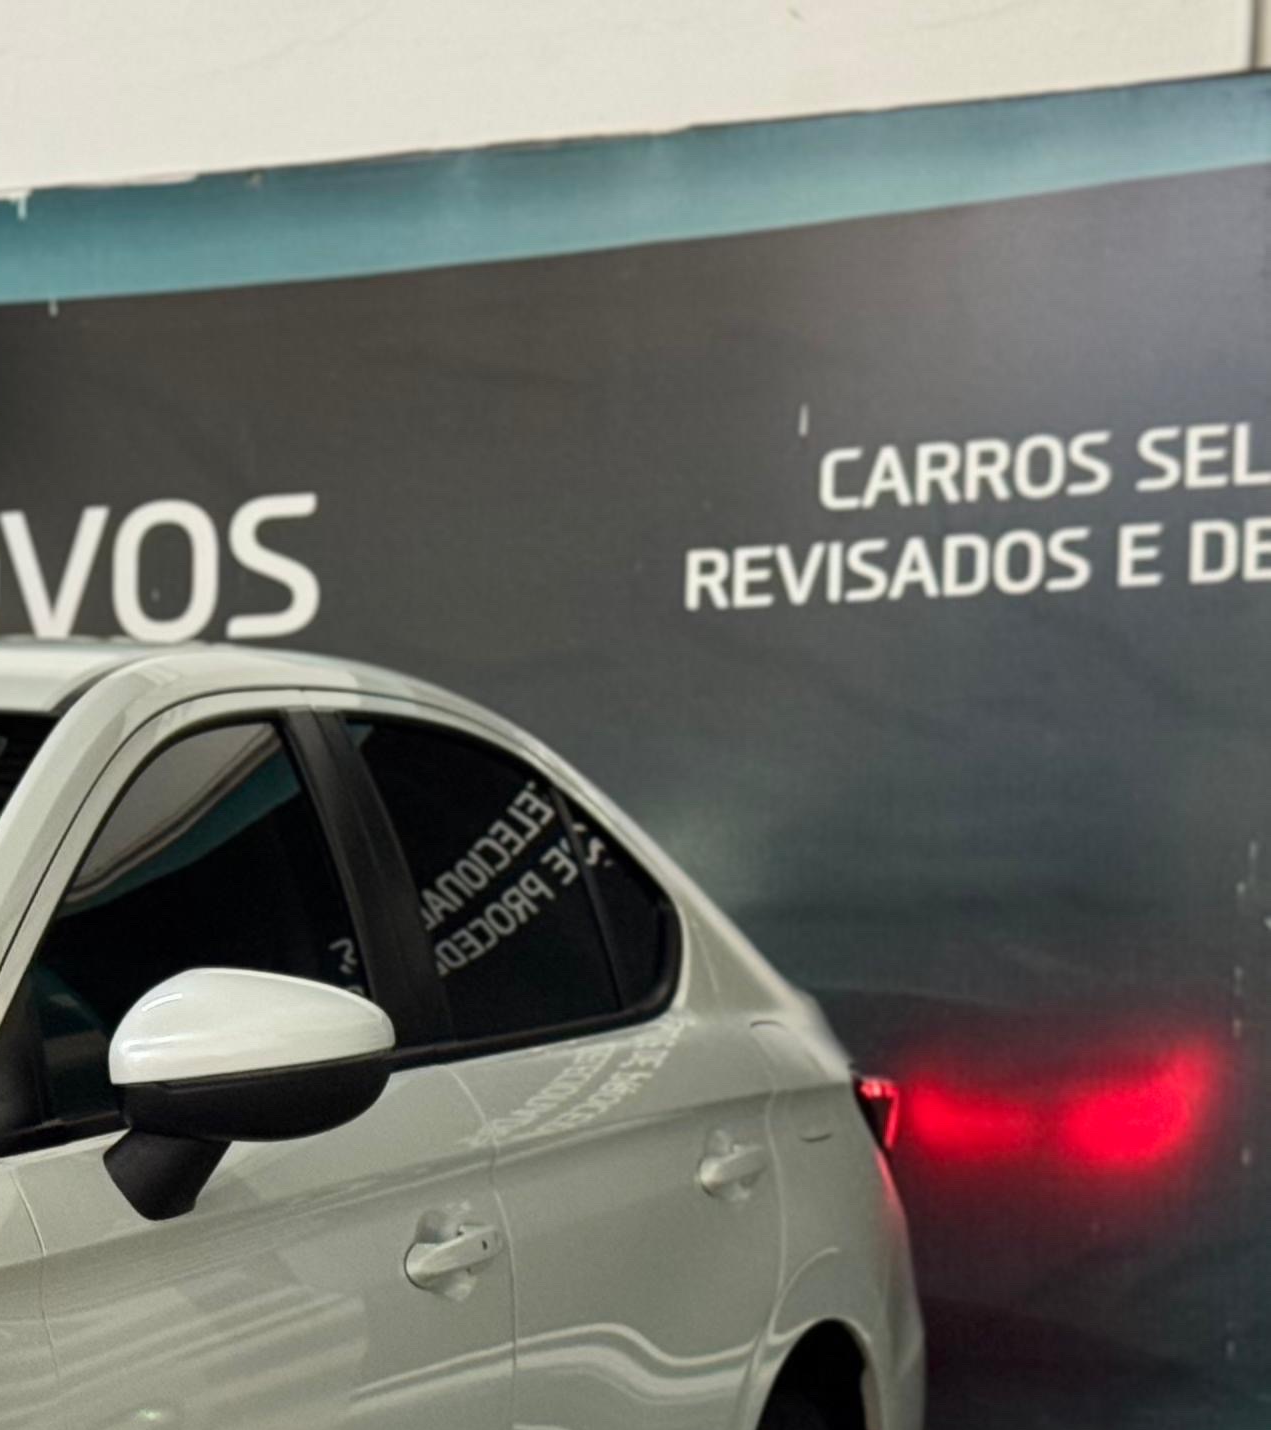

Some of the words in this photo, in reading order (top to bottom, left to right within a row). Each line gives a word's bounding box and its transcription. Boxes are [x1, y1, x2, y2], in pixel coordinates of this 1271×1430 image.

[819, 430, 1112, 510] CARROS
[1135, 421, 1271, 492] SEL
[685, 526, 1091, 610] REVISADOS
[1117, 522, 1163, 588] E
[1189, 516, 1271, 584] DE
